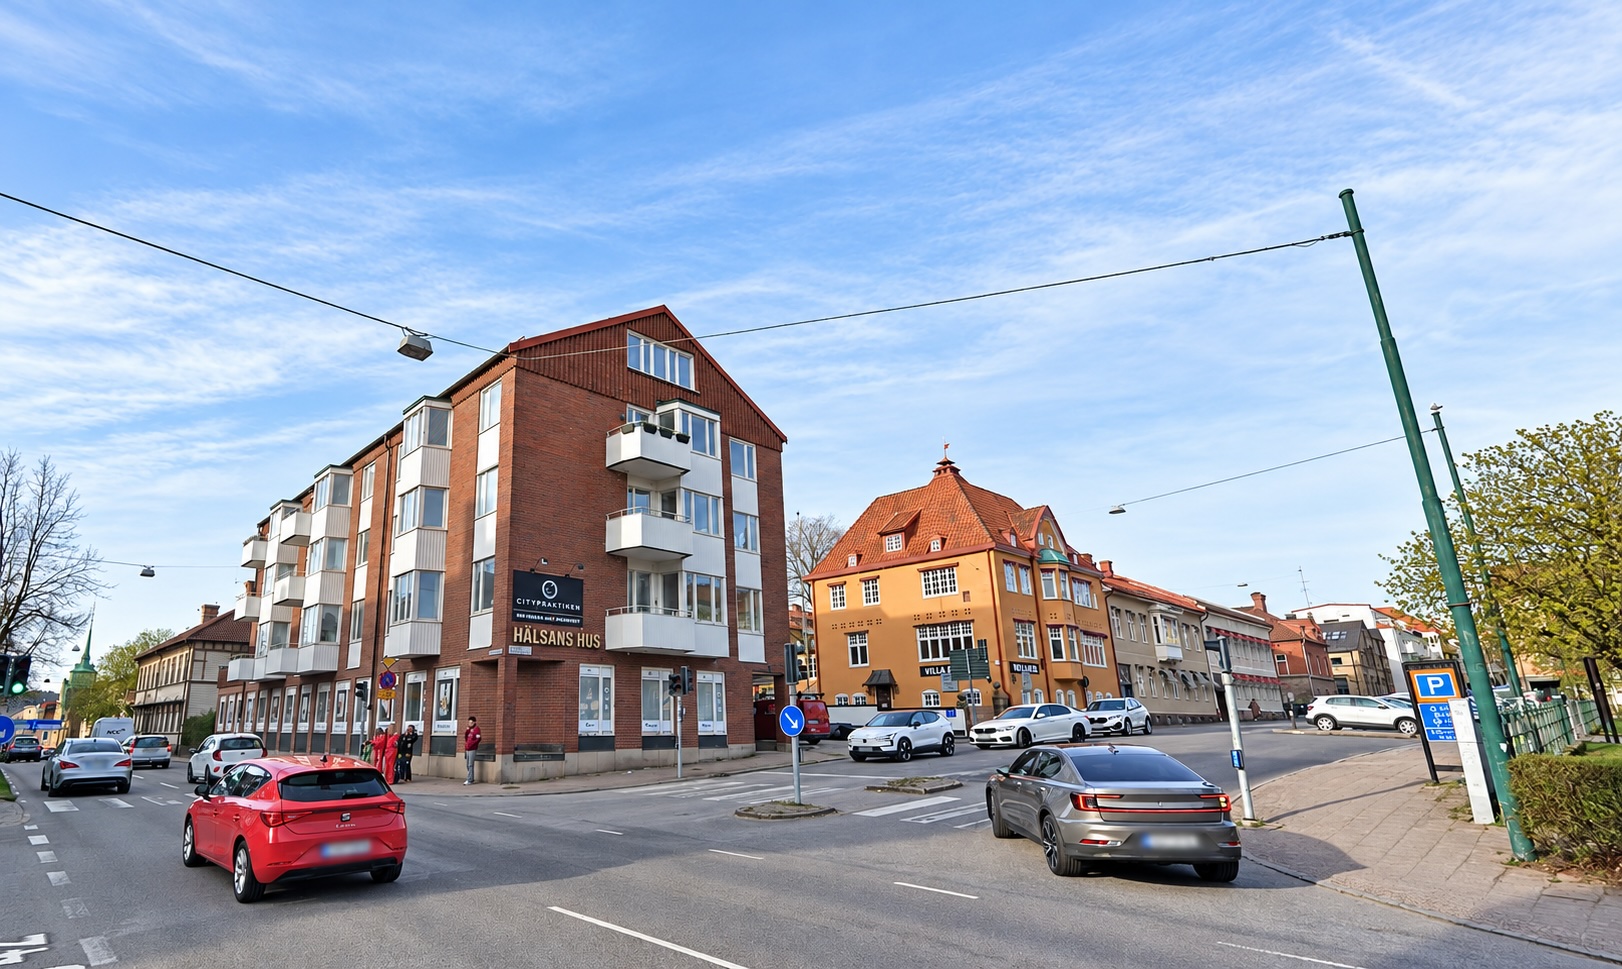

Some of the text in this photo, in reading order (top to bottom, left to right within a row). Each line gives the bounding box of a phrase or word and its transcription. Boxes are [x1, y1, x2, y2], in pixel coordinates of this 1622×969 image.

[516, 597, 580, 611] CITYPRAKTIKEN
[513, 625, 600, 648] HÄLSANS HUS
[924, 666, 946, 675] VILLA
[1426, 676, 1444, 695] P
